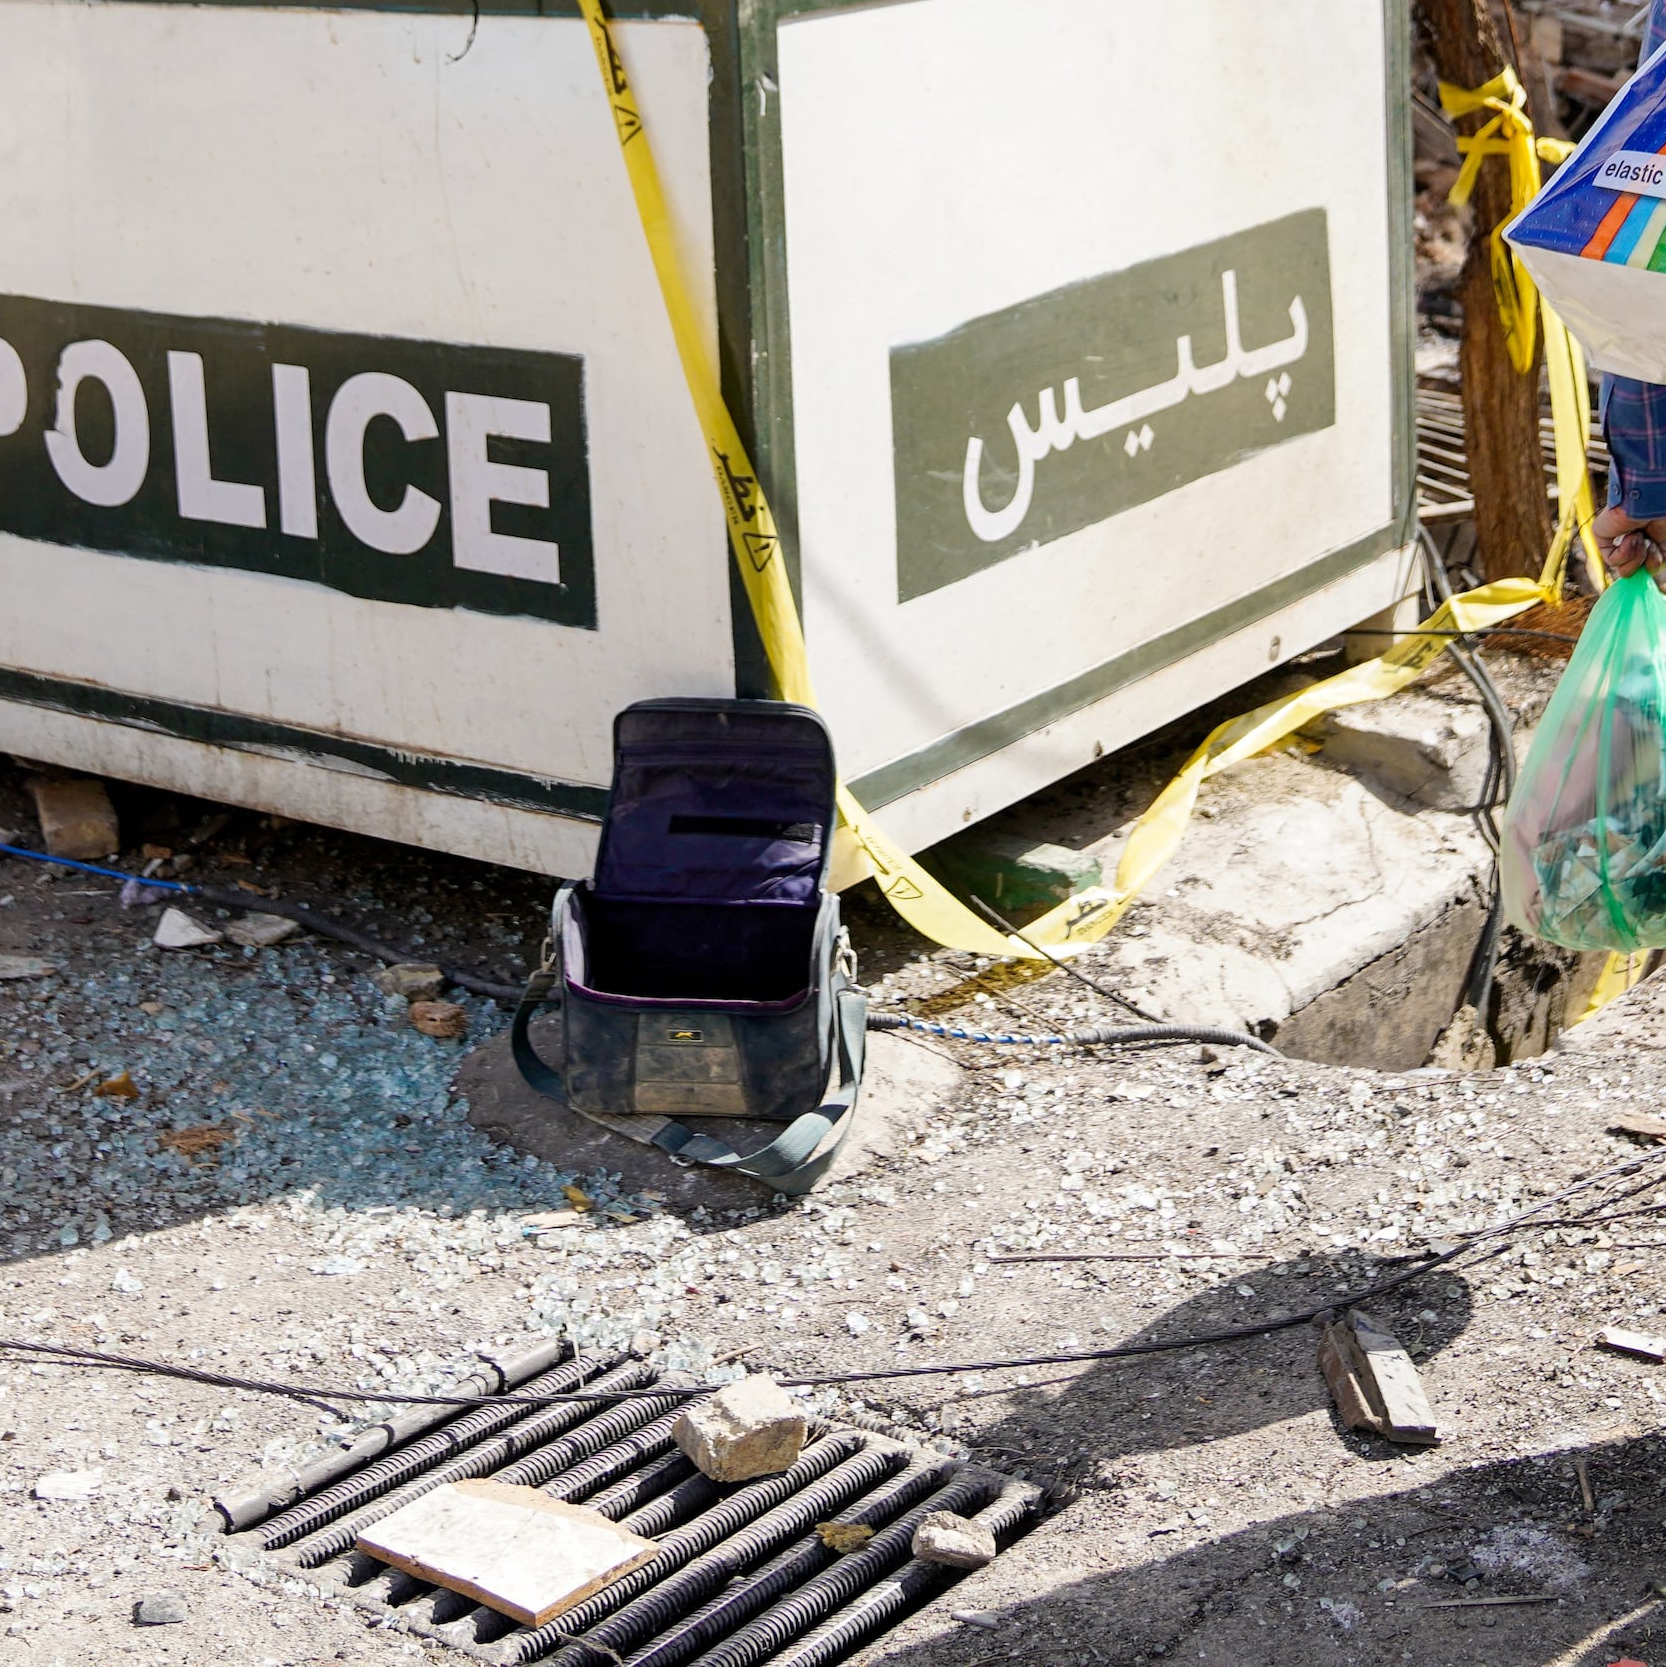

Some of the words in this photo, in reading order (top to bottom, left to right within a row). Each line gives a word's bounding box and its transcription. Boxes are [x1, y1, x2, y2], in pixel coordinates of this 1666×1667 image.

[1604, 159, 1664, 186] elastic
[962, 269, 1309, 543] پلیس
[712, 445, 766, 522] خطر
